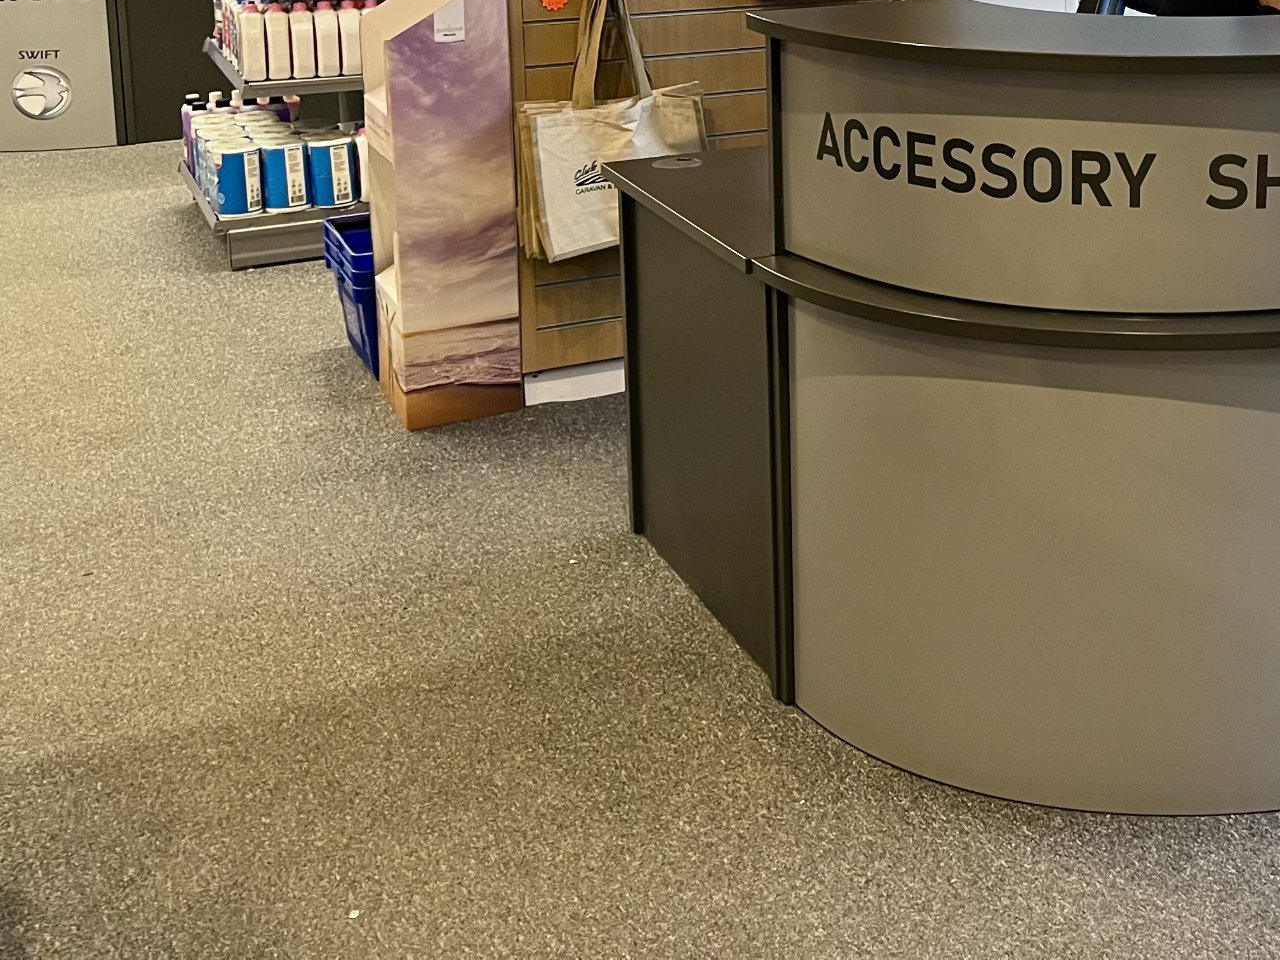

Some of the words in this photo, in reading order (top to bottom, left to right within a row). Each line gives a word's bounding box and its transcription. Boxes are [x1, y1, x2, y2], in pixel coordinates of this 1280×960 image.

[18, 50, 61, 60] SWIFT
[816, 111, 1158, 209] ACCESSORY
[576, 184, 605, 194] CARAVAN
